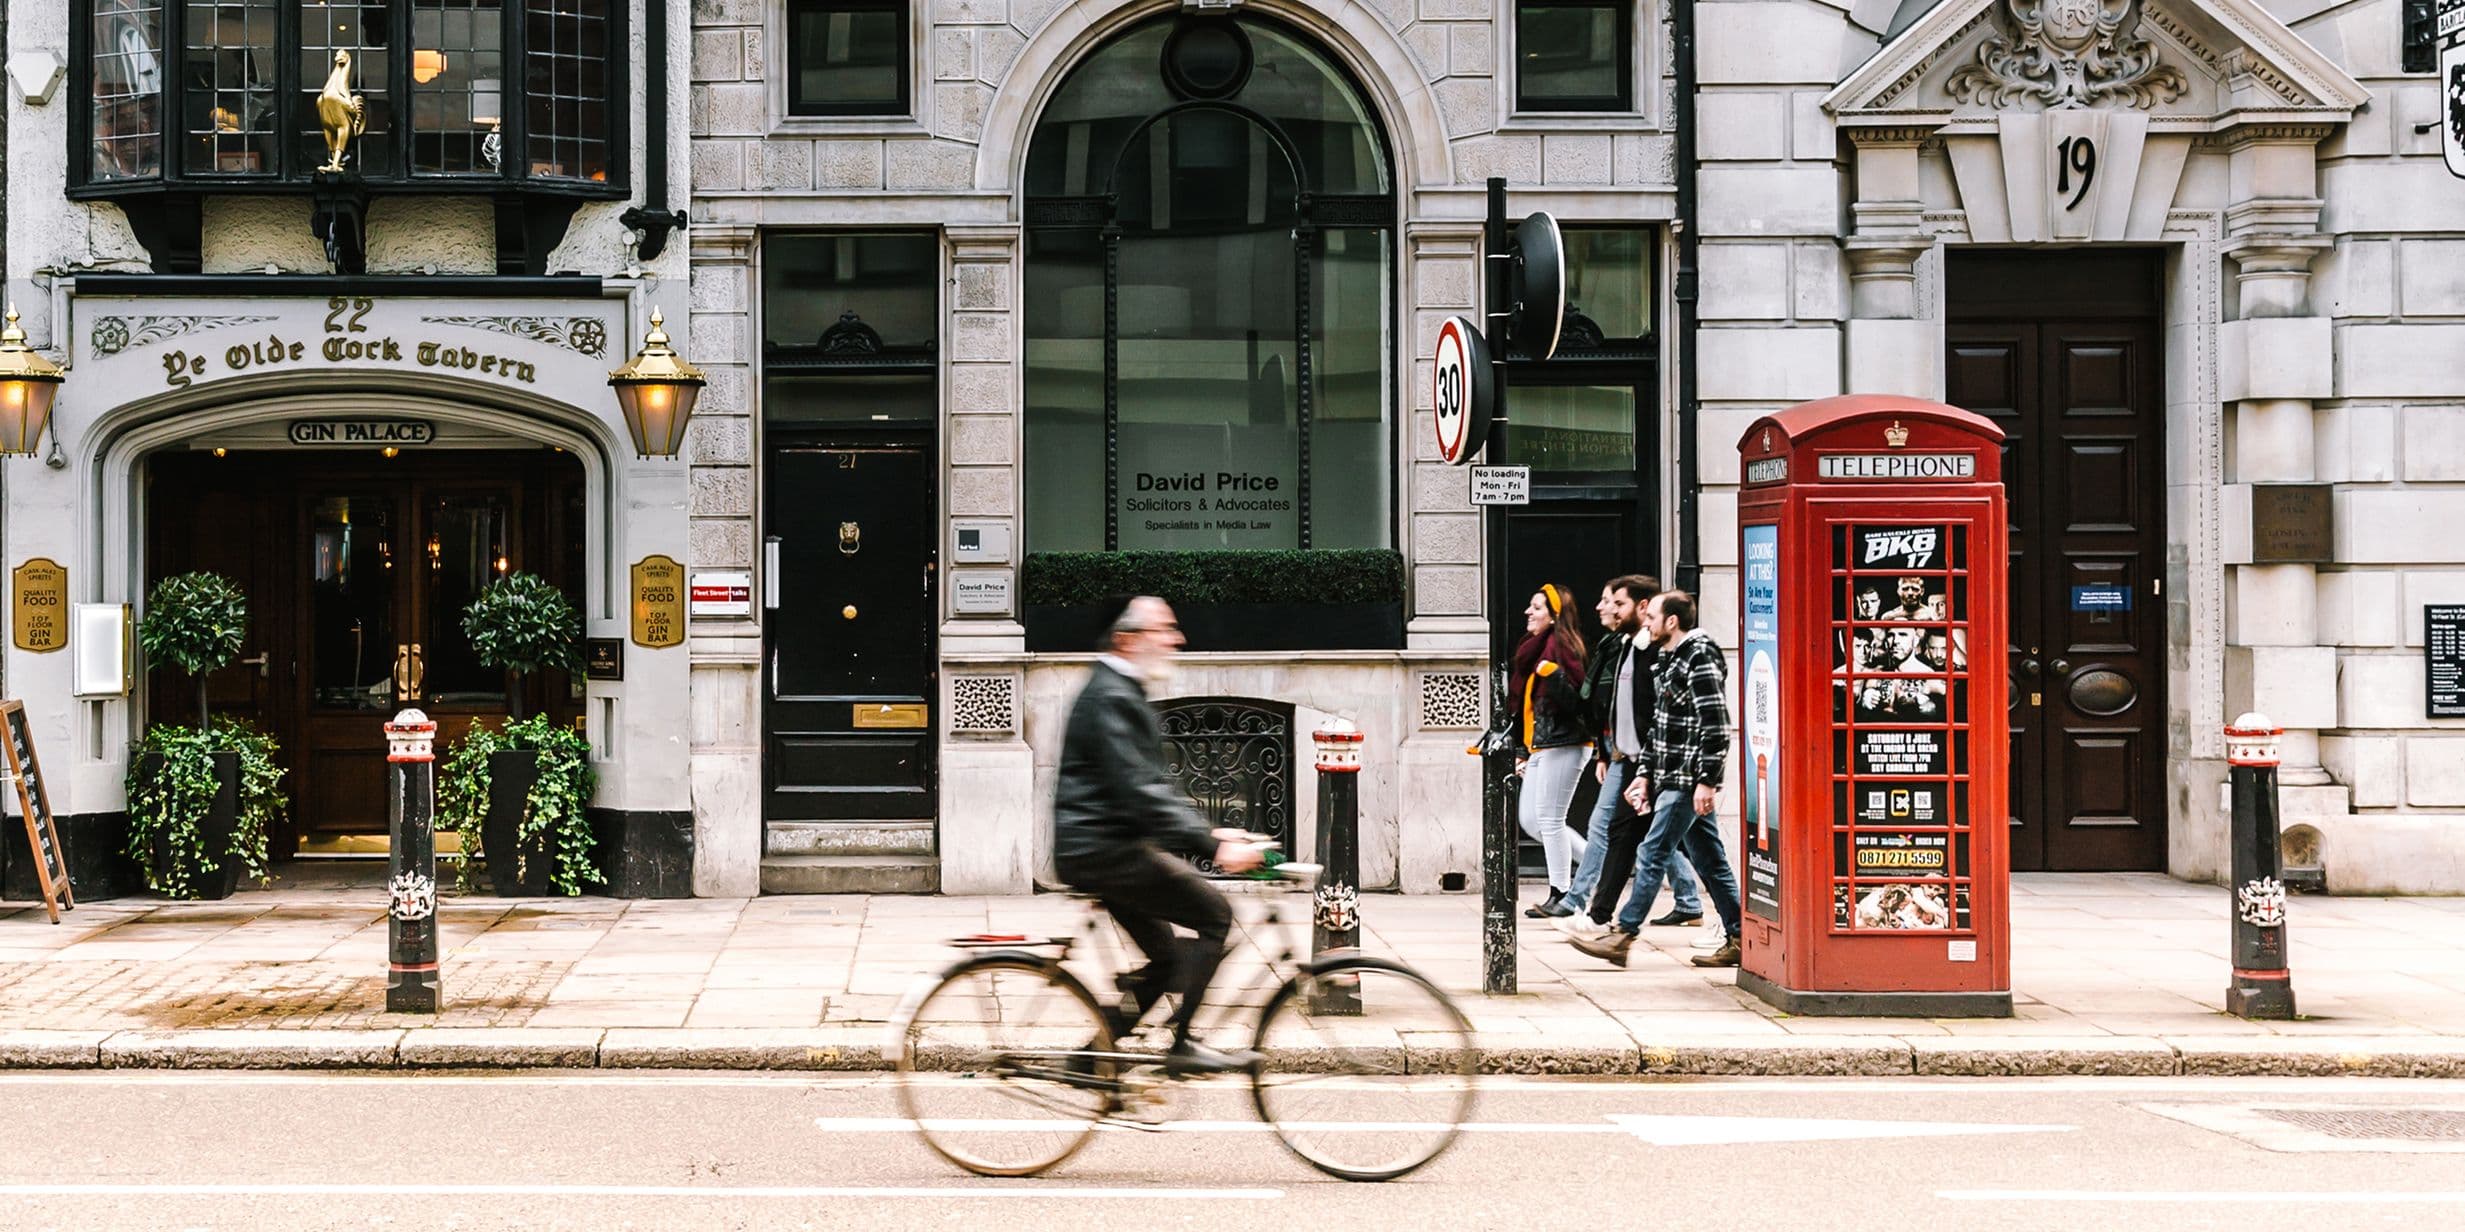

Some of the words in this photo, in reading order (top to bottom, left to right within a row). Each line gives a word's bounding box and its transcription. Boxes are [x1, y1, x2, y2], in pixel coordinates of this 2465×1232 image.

[2441, 8, 2465, 31] BARCL
[2057, 135, 2096, 212] 19
[324, 298, 374, 333] 22
[163, 350, 206, 388] Ye
[225, 335, 305, 369] Olde
[322, 336, 402, 362] Cock
[417, 340, 536, 384] Tavern
[1438, 363, 1461, 418] 30
[295, 424, 337, 442] GIN
[345, 423, 426, 442] PALACE
[839, 454, 856, 468] 21
[1823, 457, 1969, 477] TELEPHONE
[1475, 470, 1489, 478] No
[1491, 470, 1526, 479] loading
[1750, 459, 1788, 481] TELEPHONE
[1136, 472, 1205, 491] David
[1217, 472, 1279, 491] Price
[1480, 481, 1501, 489] Mon
[1508, 481, 1521, 489] Fri
[1126, 498, 1192, 511] Solicitors
[1198, 499, 1208, 511] &
[1215, 498, 1290, 511] Advocates
[1145, 520, 1199, 531] Specialists
[1204, 520, 1212, 530] in
[1216, 520, 1247, 530] Media
[1250, 520, 1272, 530] Law
[1882, 529, 1911, 537] KNUCKLE
[1911, 528, 1936, 536] BOXING
[1748, 542, 1774, 560] LOOKING
[1864, 533, 1936, 564] BKB
[1906, 551, 1932, 568] 17
[1749, 563, 1758, 580] AT
[1758, 560, 1774, 580] THIS?
[23, 590, 57, 598] QUALITY
[641, 586, 674, 594] QUALITY
[23, 596, 57, 606] FOOD
[641, 593, 675, 603] FOOD
[29, 629, 51, 638] GIN
[647, 625, 668, 634] GIN
[29, 638, 52, 646] BAR
[647, 634, 669, 642] BAR
[1867, 733, 1905, 744] SATURDAY
[1889, 754, 1901, 763] LIVE
[1918, 754, 1931, 763] 7PM
[1859, 851, 1887, 864] 0871
[1888, 851, 1908, 864] 271
[1911, 852, 1941, 865] 5599
